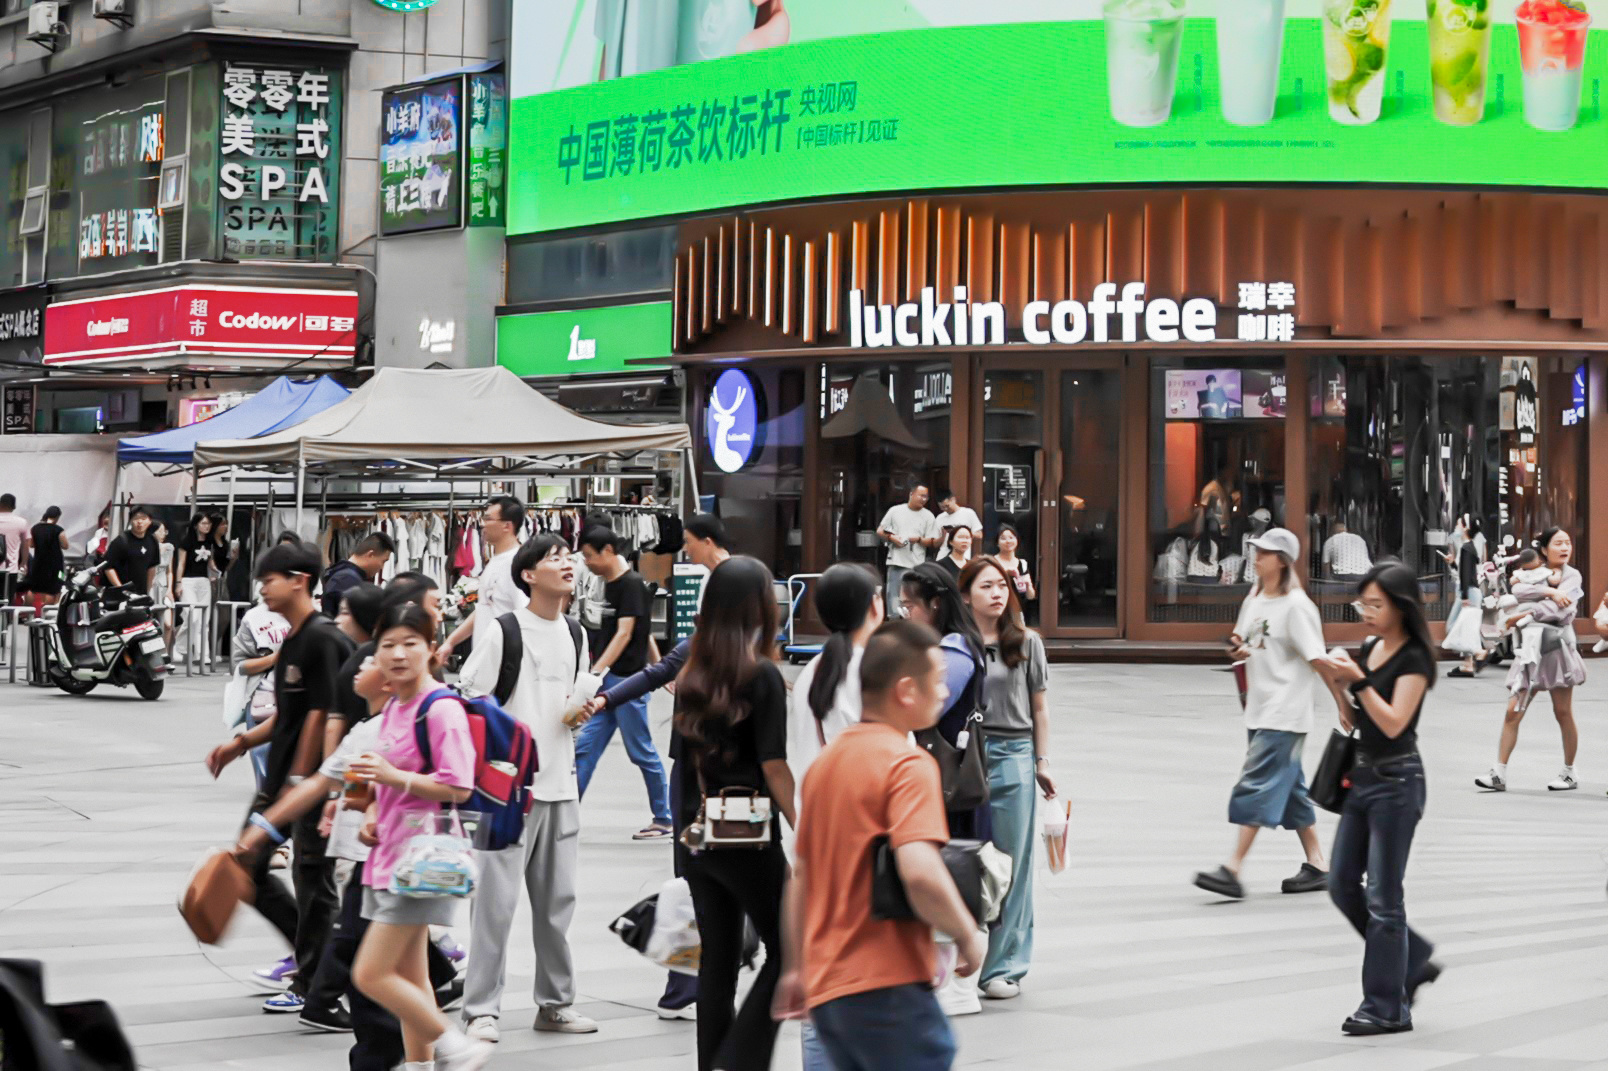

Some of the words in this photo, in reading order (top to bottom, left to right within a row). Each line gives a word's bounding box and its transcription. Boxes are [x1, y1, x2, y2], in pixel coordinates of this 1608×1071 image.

[223, 68, 330, 111] 零零年
[799, 81, 857, 116] 央视网
[221, 114, 329, 159] 美式
[558, 88, 792, 186] 中国薄荷茶饮标杆
[219, 163, 329, 203] SPA
[227, 205, 288, 231] SPA
[1237, 281, 1295, 310] 瑞幸
[189, 299, 208, 337] 超市
[219, 311, 298, 330] Codow
[305, 315, 355, 332] 可多
[849, 286, 1006, 347] luckin
[1023, 282, 1217, 344] coffee
[1237, 312, 1295, 342] 咖啡
[6, 416, 31, 426] SPA
